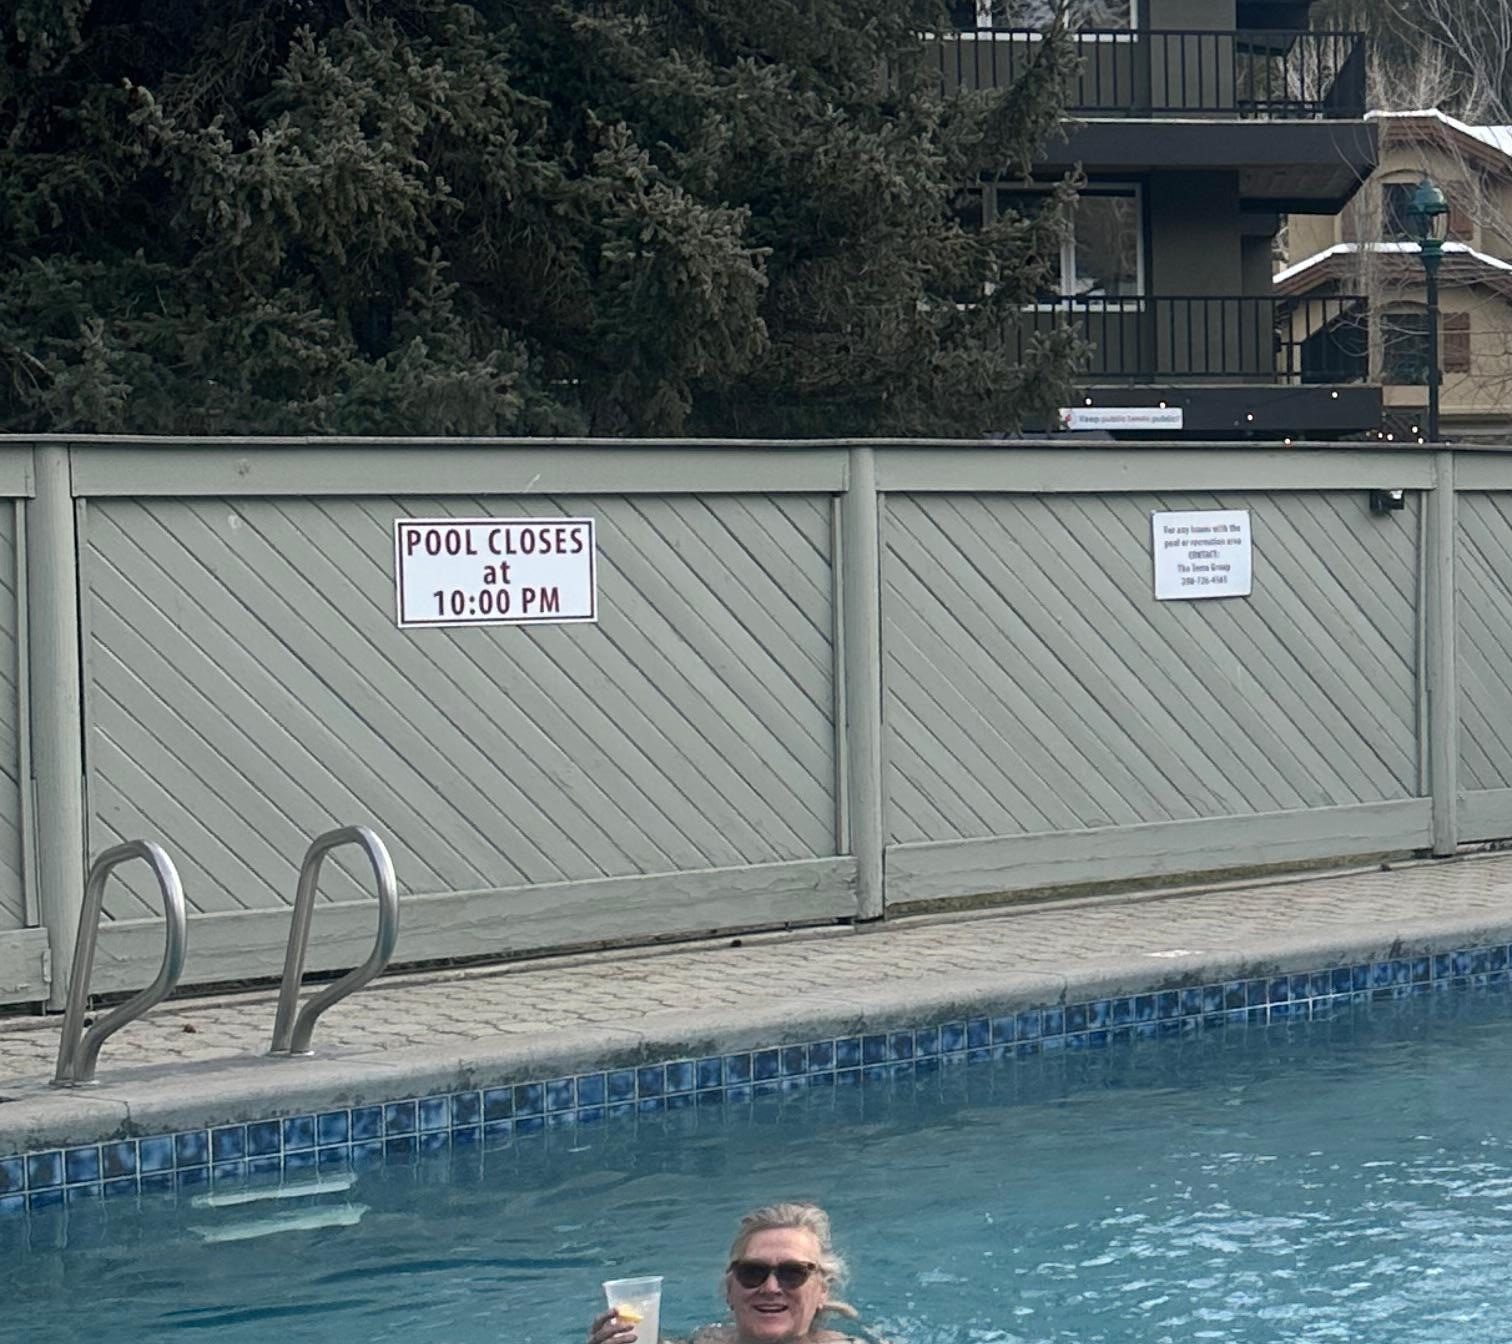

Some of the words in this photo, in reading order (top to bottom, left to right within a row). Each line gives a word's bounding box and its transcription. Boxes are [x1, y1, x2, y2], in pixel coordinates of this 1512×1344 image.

[407, 529, 478, 556] POOL
[488, 528, 584, 555] CLOSES
[483, 560, 511, 585] at
[433, 589, 510, 616] 10:00
[522, 587, 560, 613] PM
